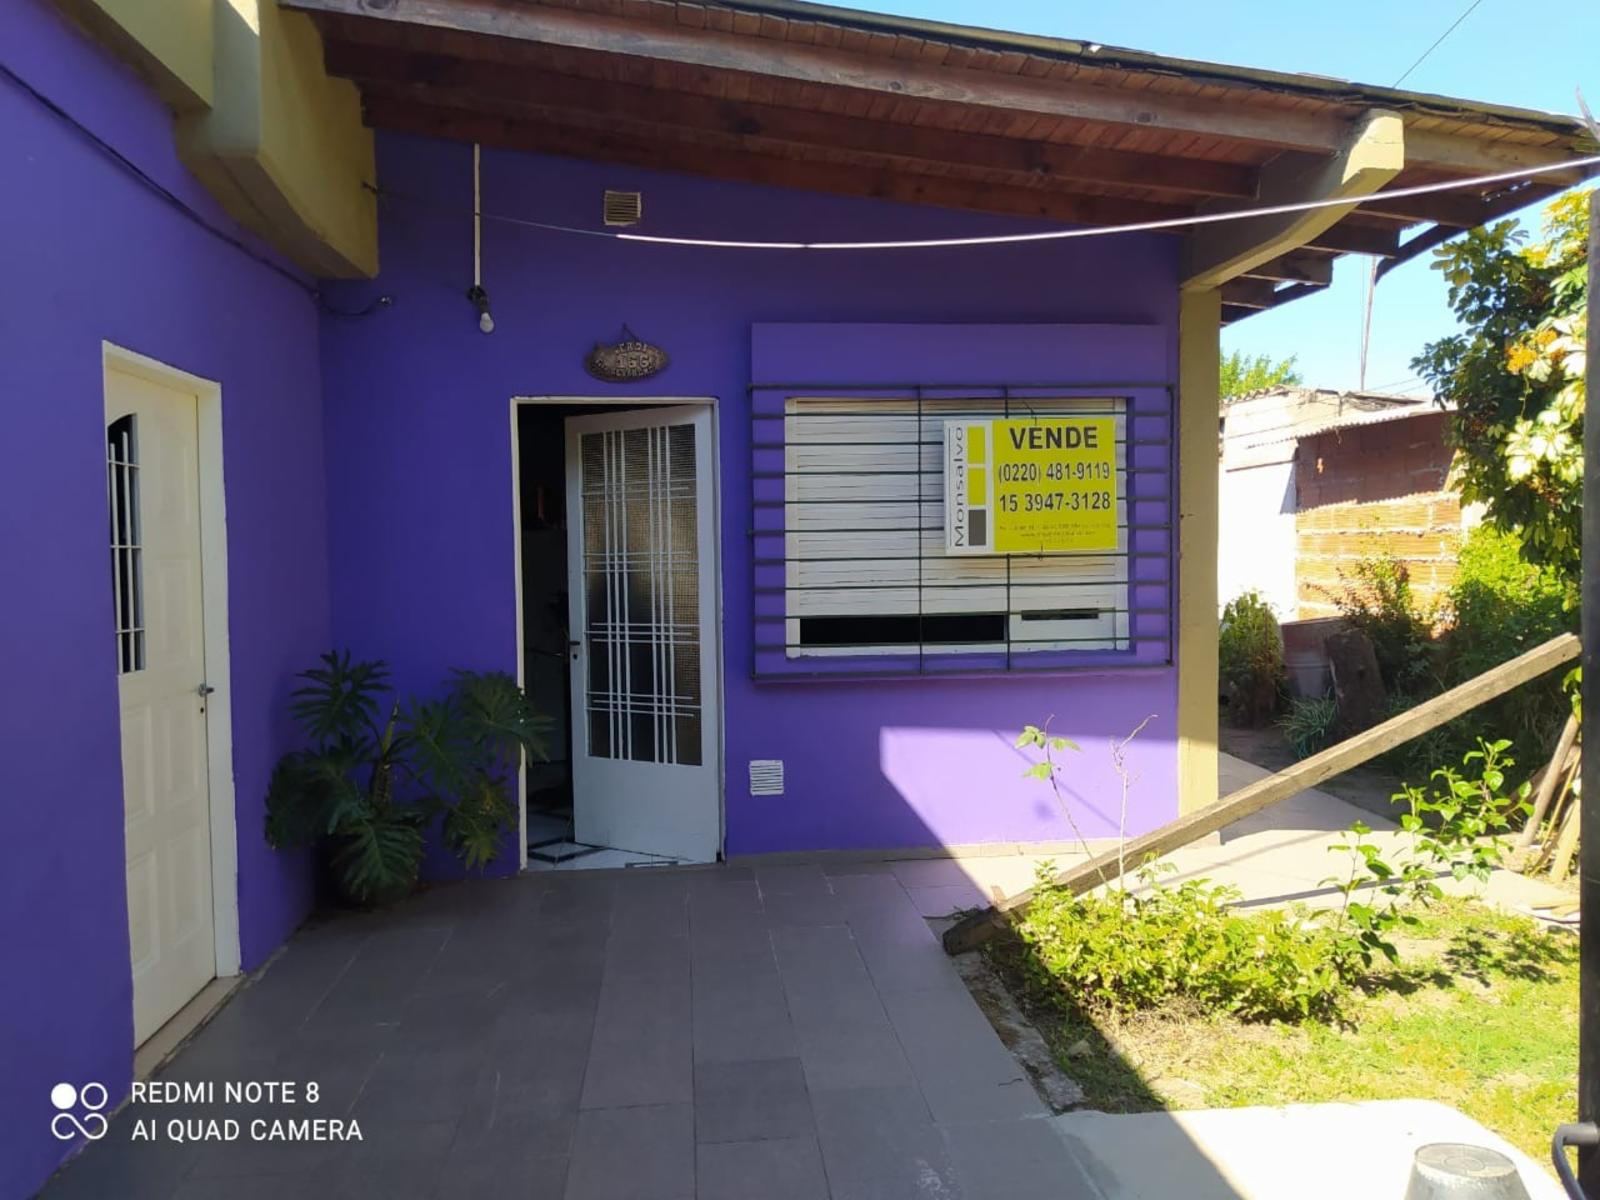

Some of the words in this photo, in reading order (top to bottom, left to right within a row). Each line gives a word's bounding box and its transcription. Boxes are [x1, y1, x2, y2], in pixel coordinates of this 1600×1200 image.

[1009, 426, 1098, 449] VENDE
[999, 463, 1042, 484] (0220)
[1046, 462, 1110, 481] 481-9119
[953, 426, 964, 547] Monsalvo
[1000, 495, 1018, 512] 15
[1025, 491, 1111, 512] 3947-3128
